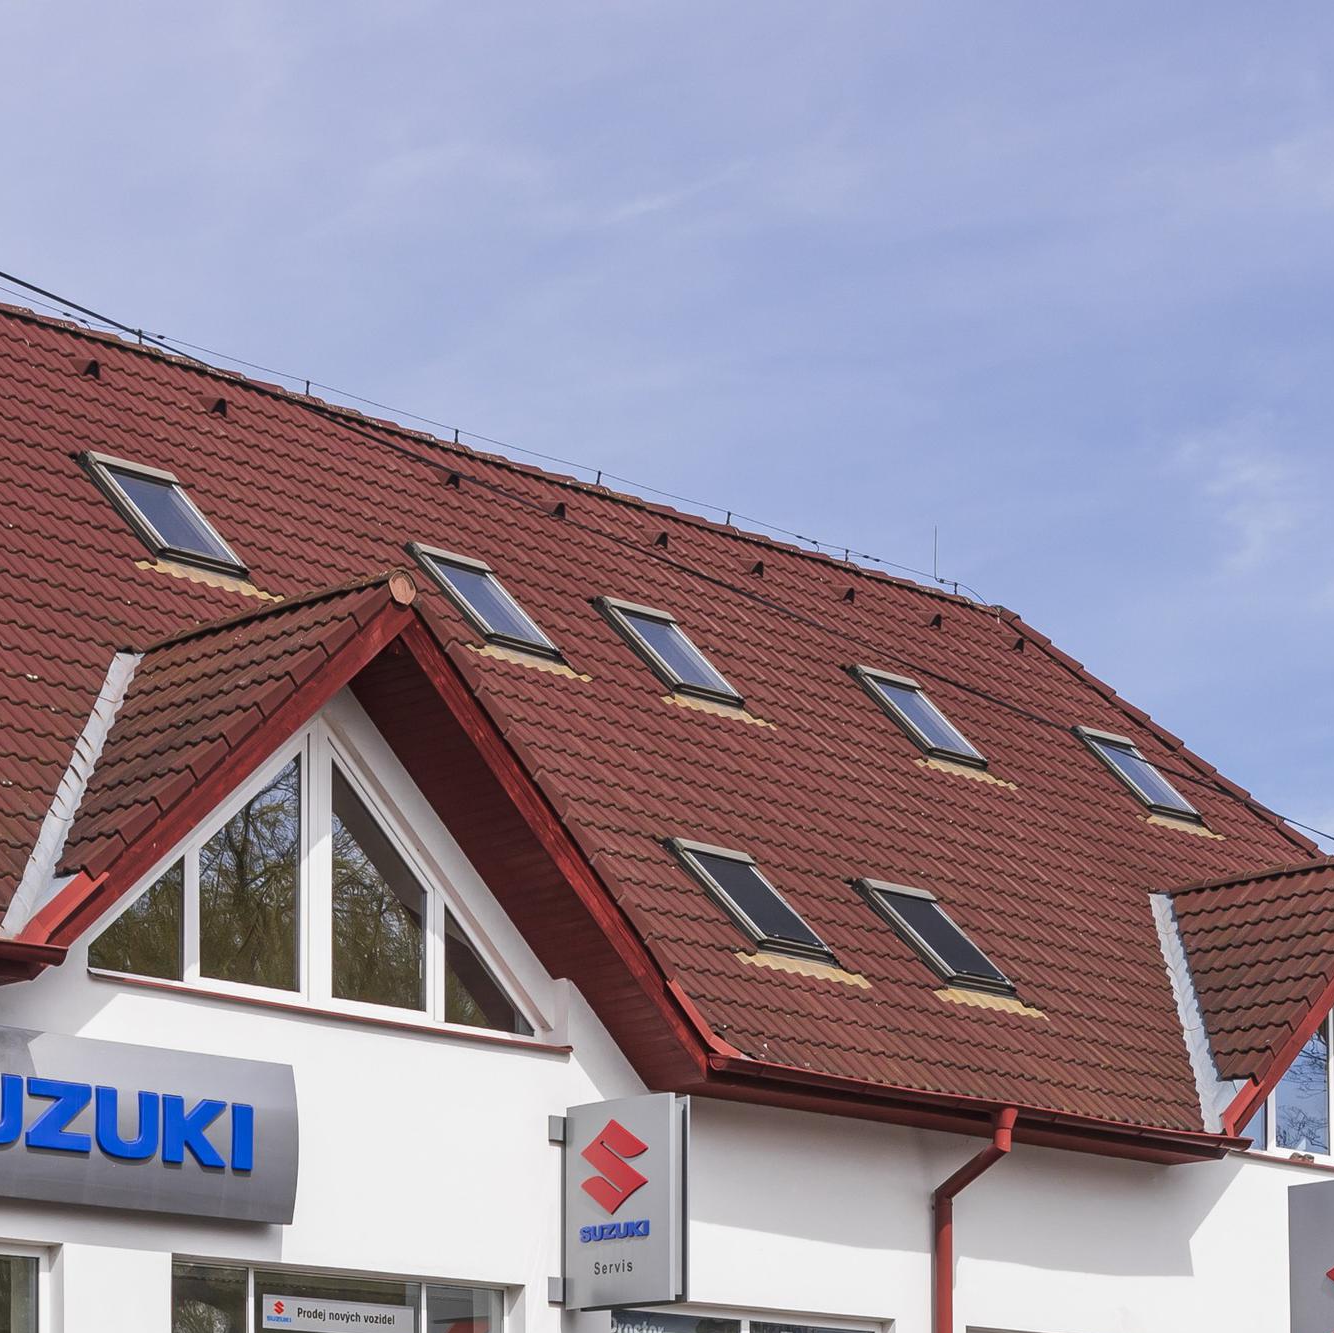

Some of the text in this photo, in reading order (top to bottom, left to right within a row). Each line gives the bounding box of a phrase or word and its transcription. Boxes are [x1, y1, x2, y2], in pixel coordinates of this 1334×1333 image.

[579, 1219, 650, 1243] SUZUKI
[593, 1259, 633, 1276] Servis
[297, 1307, 395, 1325] Prodej nových vozidel
